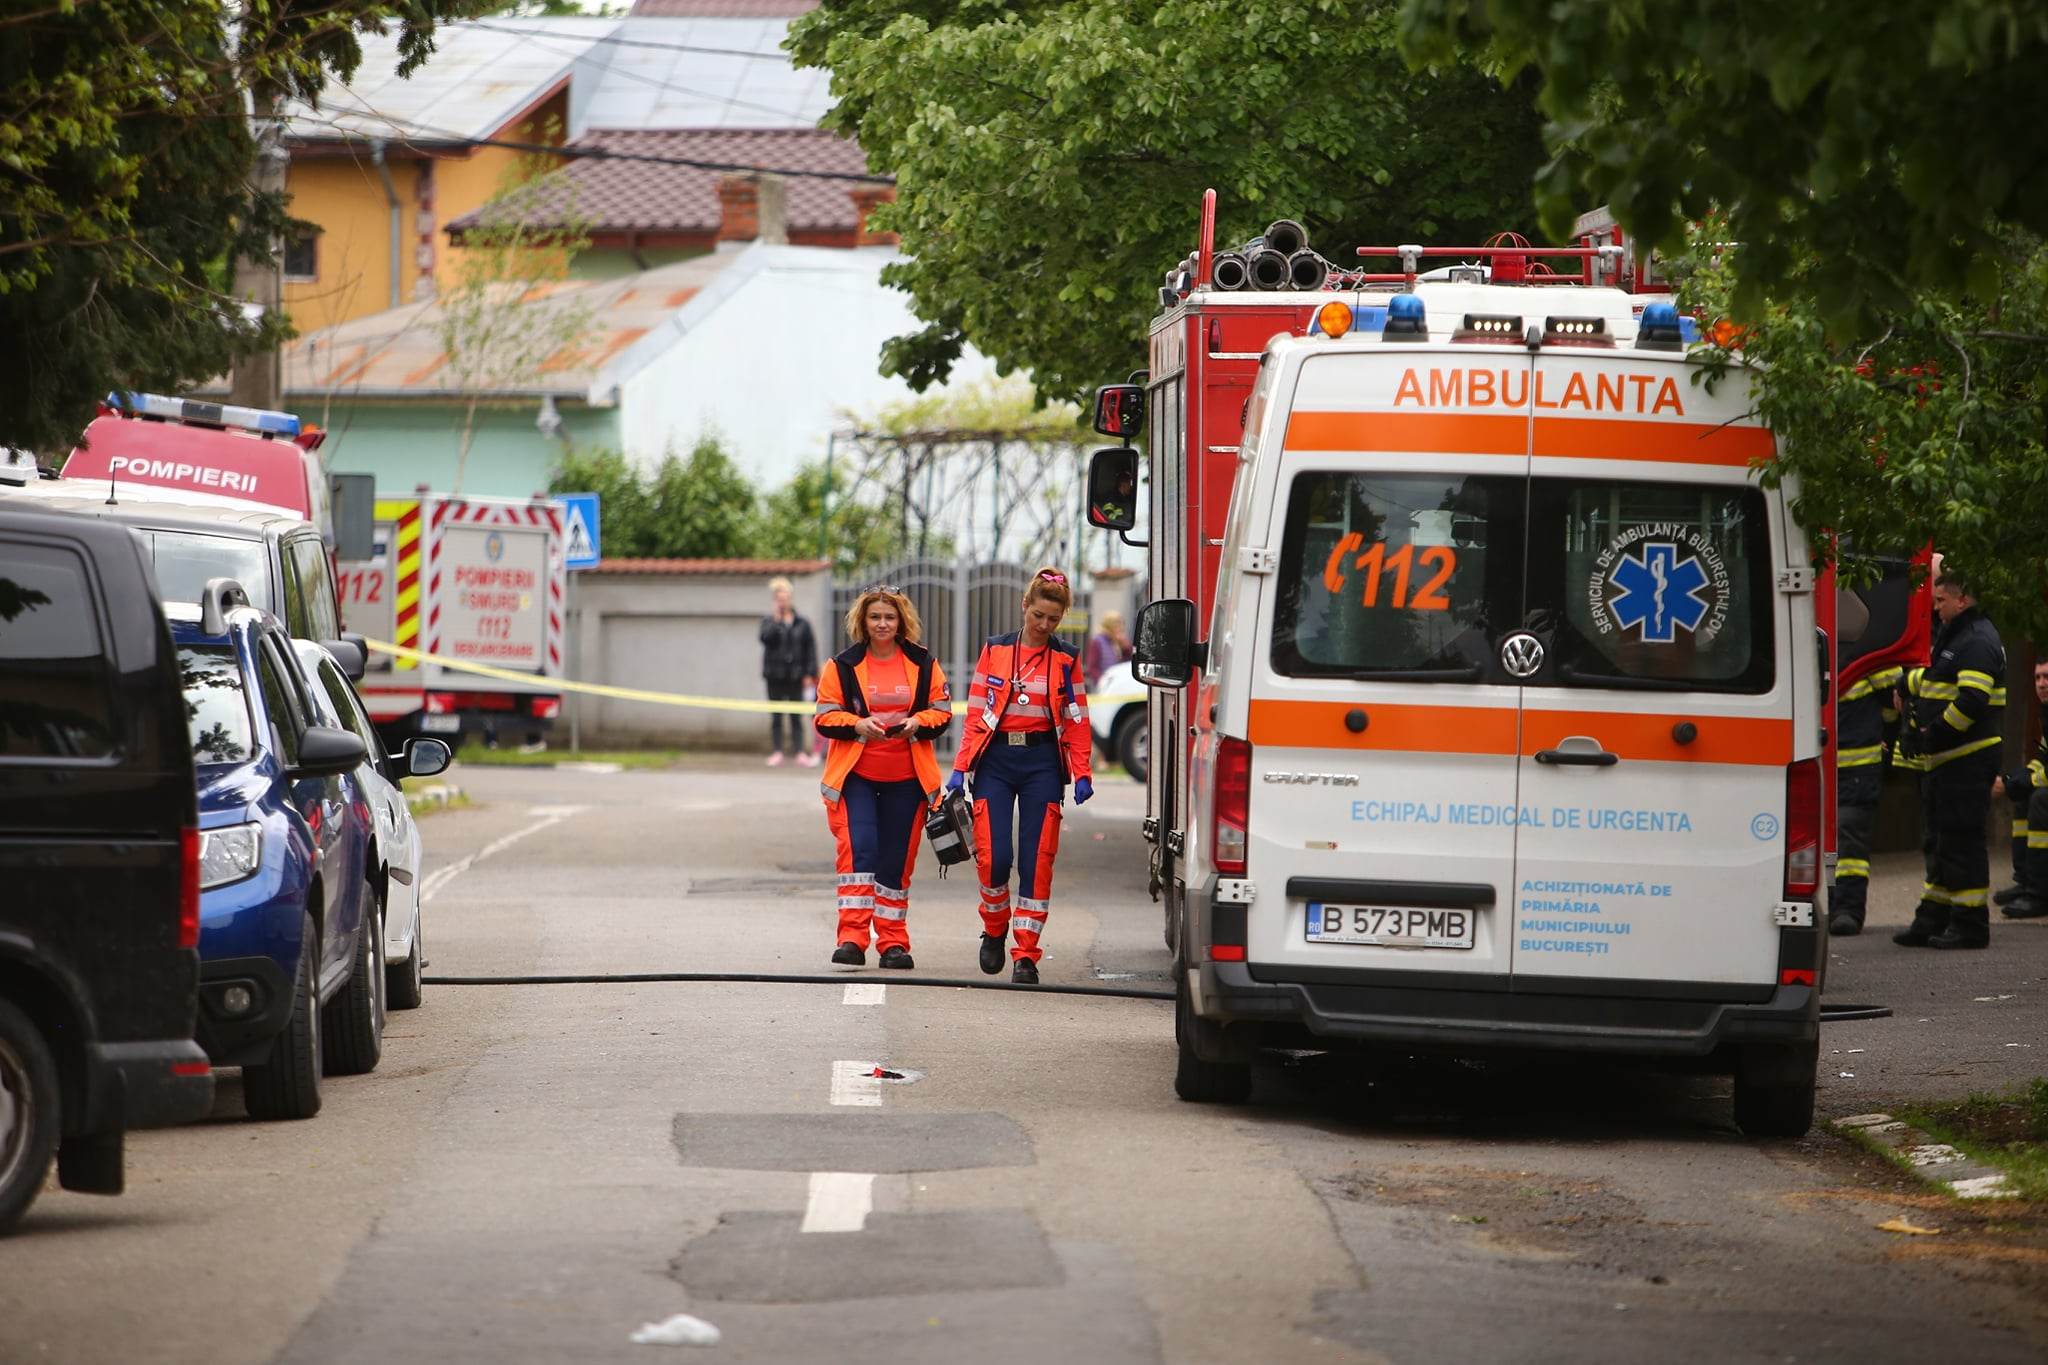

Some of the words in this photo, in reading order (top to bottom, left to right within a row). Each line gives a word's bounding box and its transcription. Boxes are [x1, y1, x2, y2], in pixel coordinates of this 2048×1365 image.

[1393, 368, 1685, 416] AMBULANTA
[108, 455, 258, 493] POMPIERII
[1596, 549, 1615, 568] DE
[1355, 542, 1457, 610] 112
[1588, 569, 1613, 635] SERVICIUL
[1263, 771, 1360, 787] CRAFTER
[1351, 801, 1441, 823] ECHIPAJ
[1449, 804, 1545, 828] MEDICAL
[1552, 808, 1581, 828] DE
[1588, 809, 1692, 833] URGENTA
[1650, 885, 1672, 896] DE
[1521, 898, 1601, 914] PRIMĂRIA
[1308, 922, 1321, 933] RO
[1324, 907, 1343, 933] B
[1521, 920, 1631, 934] MUNICIPIULUI
[1520, 940, 1609, 956] BUCUREȘTI
